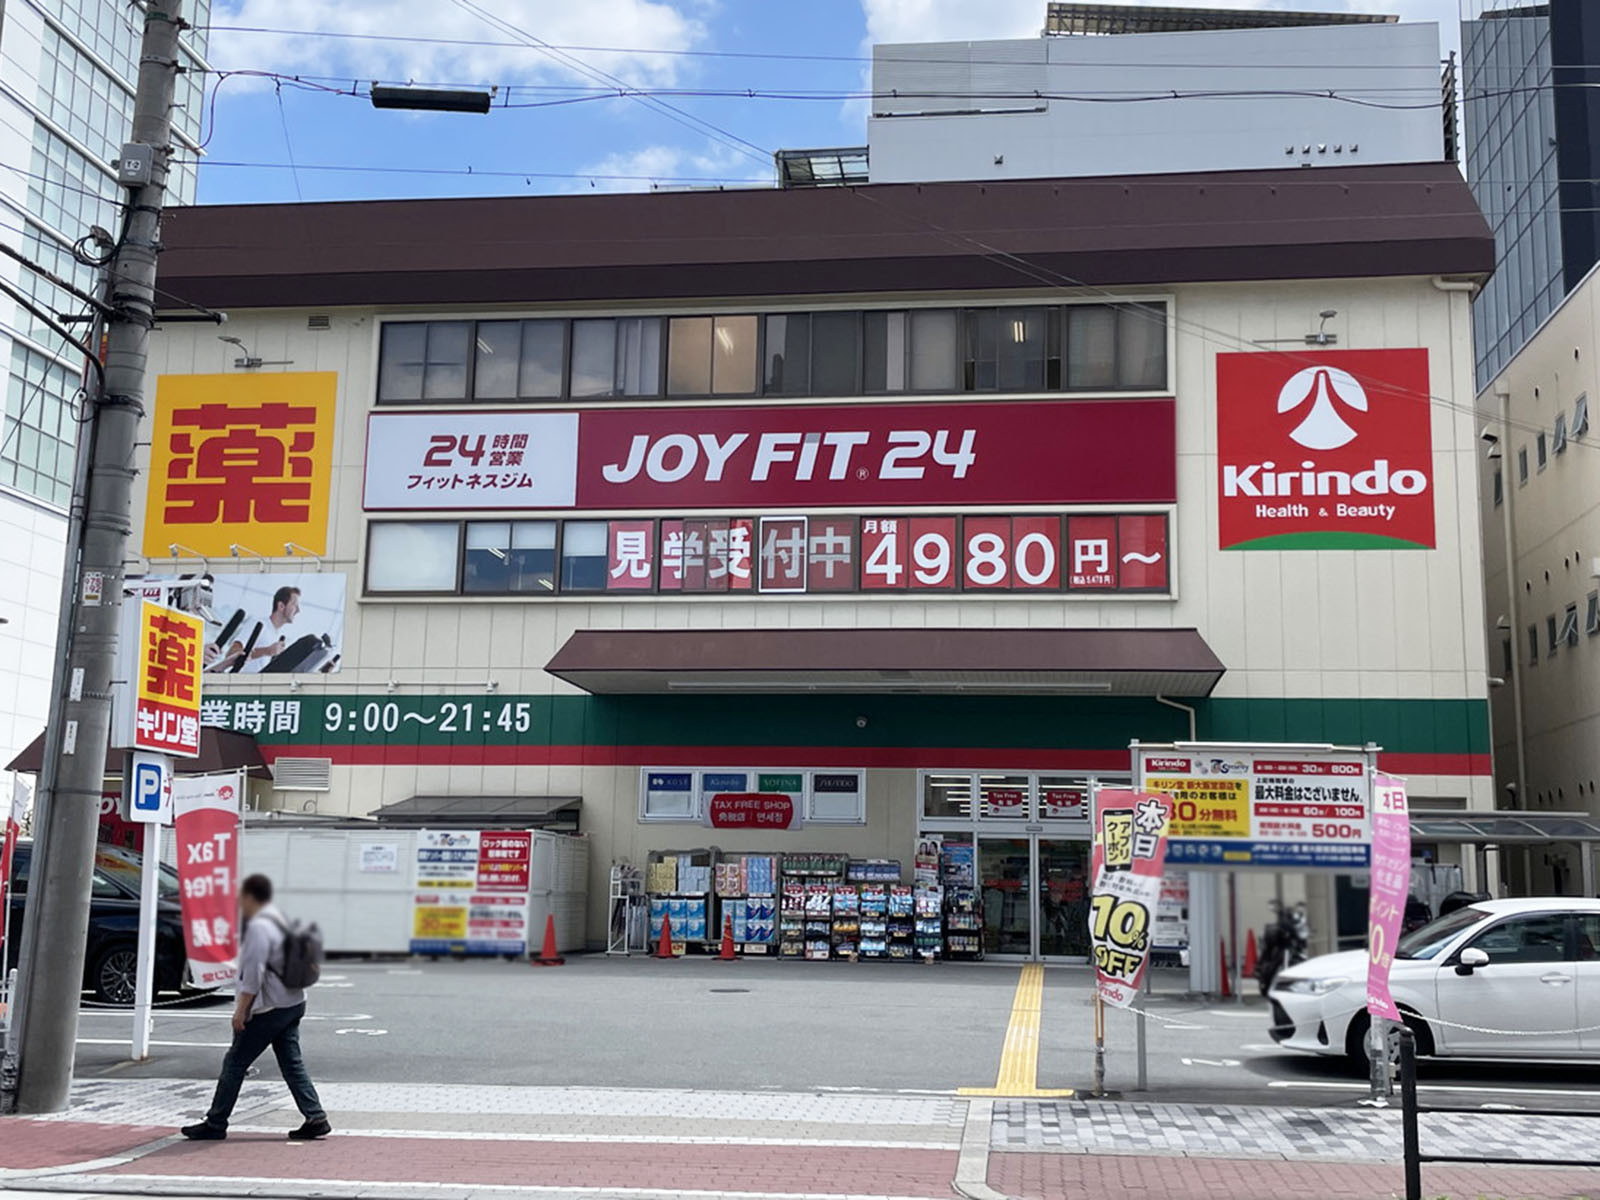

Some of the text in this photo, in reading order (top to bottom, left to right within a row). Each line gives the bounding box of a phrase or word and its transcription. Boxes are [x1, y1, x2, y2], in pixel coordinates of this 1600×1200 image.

[164, 402, 316, 524] 薬
[423, 433, 529, 467] 24 時間
[489, 451, 524, 466] 営業
[602, 432, 749, 484] JOY
[878, 429, 976, 479] 24
[407, 472, 533, 490] フィットネスジム
[1223, 459, 1427, 497] Kirindo
[863, 519, 898, 534] 月額
[1255, 503, 1396, 520] Health & Beauty
[610, 526, 852, 581] 見学受付中
[146, 614, 196, 702] 薬
[137, 707, 198, 748] キリン堂
[1151, 759, 1187, 768] Kirindo
[139, 769, 159, 804] P
[714, 799, 791, 810] TAX FREE SHOP
[1255, 785, 1363, 803] 最大料金はございません。
[1107, 821, 1119, 863] クーポン
[1118, 821, 1131, 861] アプリ
[1132, 799, 1168, 860] 本日
[1312, 824, 1362, 839] 500円
[1092, 894, 1149, 952] 10%
